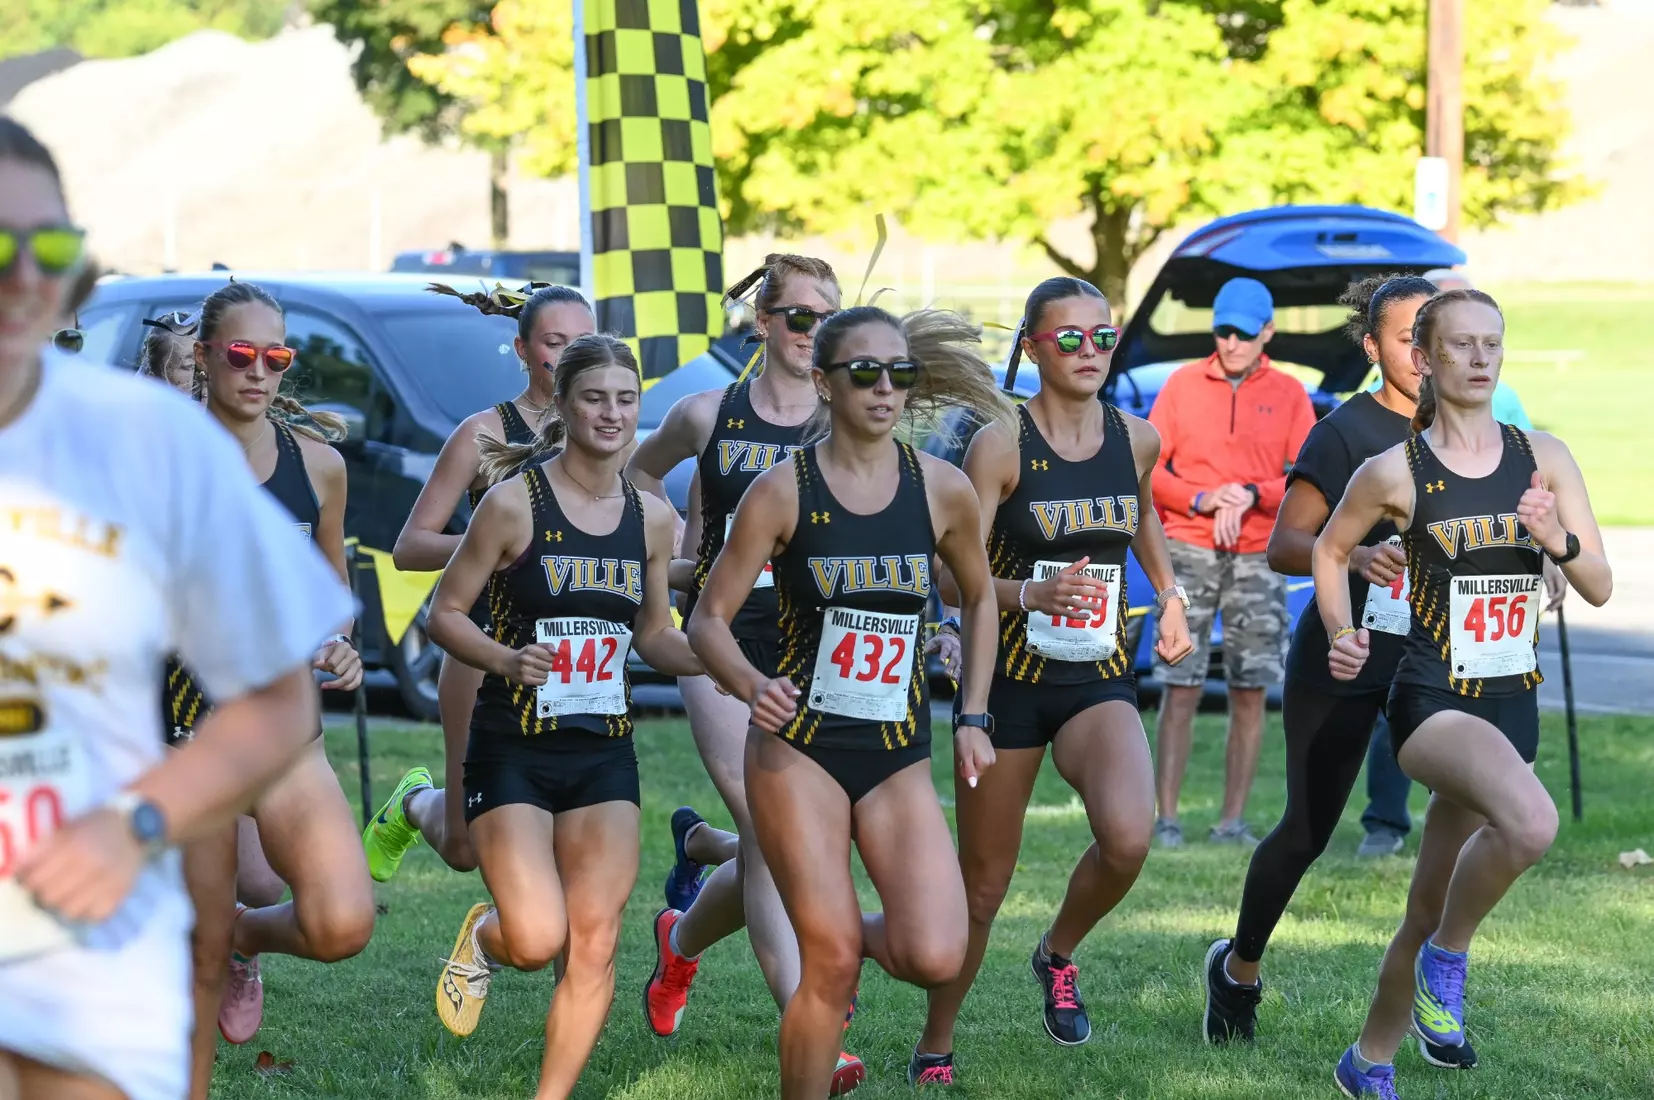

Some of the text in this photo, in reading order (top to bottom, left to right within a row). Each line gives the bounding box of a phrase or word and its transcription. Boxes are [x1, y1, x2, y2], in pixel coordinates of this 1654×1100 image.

[1029, 495, 1139, 541] VILLE
[541, 555, 644, 605] VILLE
[807, 553, 931, 599] VILLE
[1040, 564, 1116, 583] MIRSVILLE
[1457, 578, 1539, 595] MILLERSVILLE
[543, 620, 627, 637] MILLERSVILLE
[831, 610, 915, 636] MILLERSVILLE
[1463, 594, 1529, 643] 456
[551, 636, 618, 684] 442
[830, 631, 907, 685] 432
